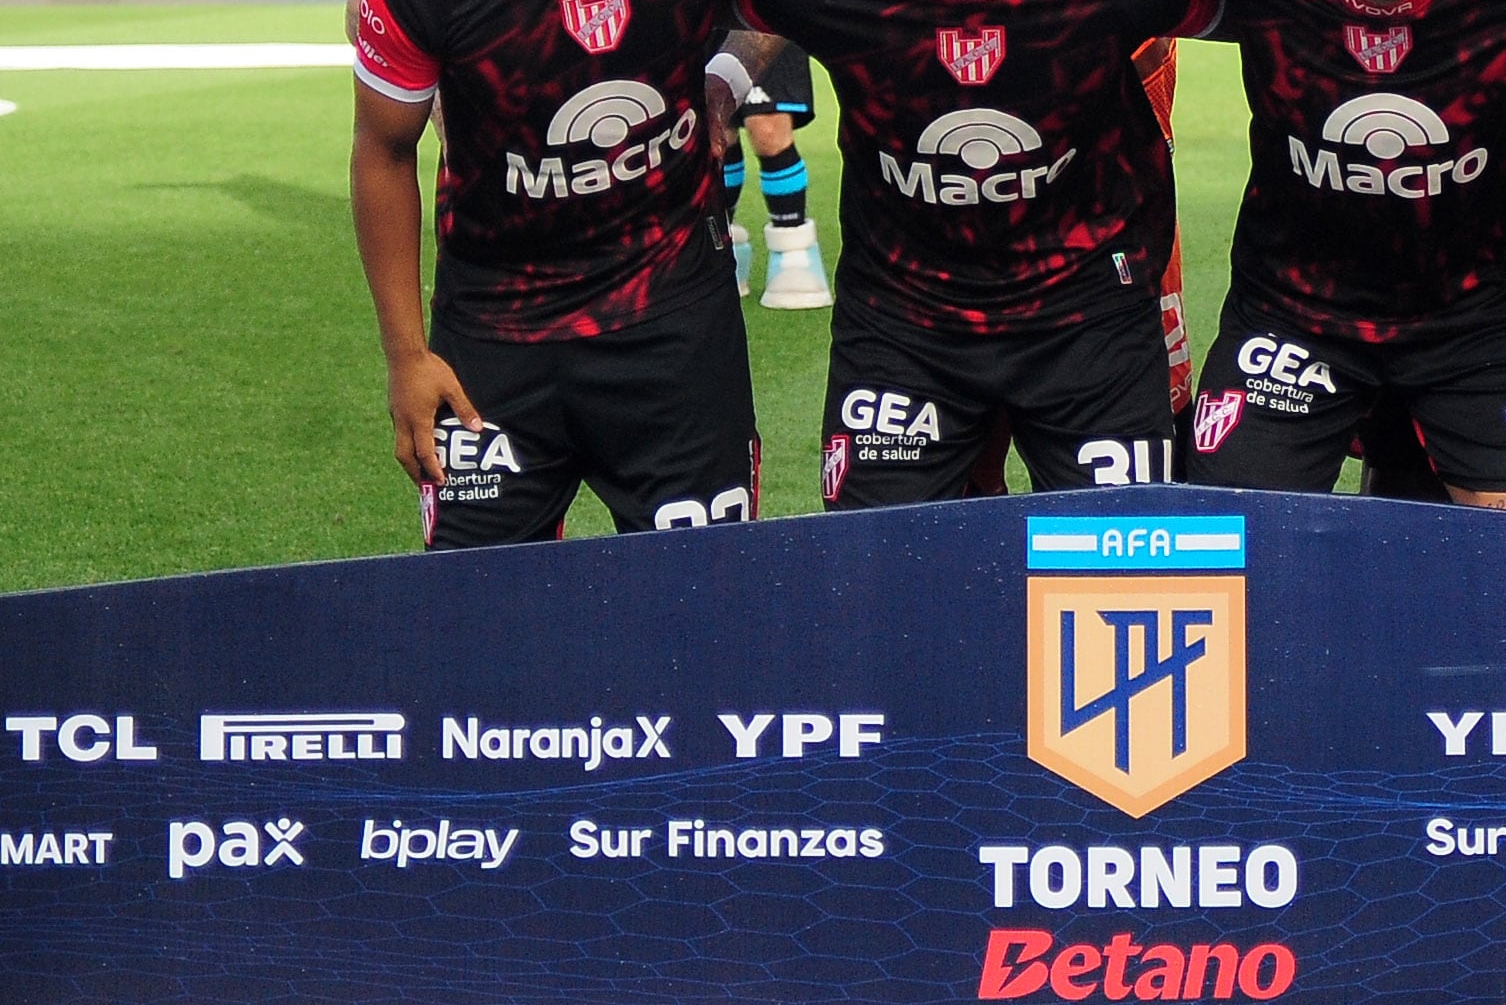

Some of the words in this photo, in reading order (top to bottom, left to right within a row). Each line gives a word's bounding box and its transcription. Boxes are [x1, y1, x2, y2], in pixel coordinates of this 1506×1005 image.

[506, 107, 697, 199] Macro
[1288, 134, 1489, 200] Macro
[879, 148, 1077, 206] Macro
[1237, 336, 1337, 394] GEA
[1246, 377, 1314, 404] cobertura
[1246, 390, 1267, 406] de
[1269, 395, 1310, 414] salud
[841, 388, 941, 442] GEA
[855, 432, 928, 447] cobertura
[858, 448, 877, 461] de
[881, 448, 920, 462] salud
[439, 486, 463, 502] de
[467, 485, 500, 501] salud
[441, 472, 502, 487] obertura
[1102, 529, 1170, 558] AFA
[5, 714, 157, 762] TCL
[200, 713, 405, 760] PIRELLI
[442, 716, 671, 771] NaranjaX
[717, 714, 885, 758] YPF
[168, 817, 304, 878] pax
[569, 819, 653, 858] Sur
[667, 820, 885, 858] Finanzas
[978, 844, 1298, 909] TORNEO
[977, 928, 1297, 1000] Betano
